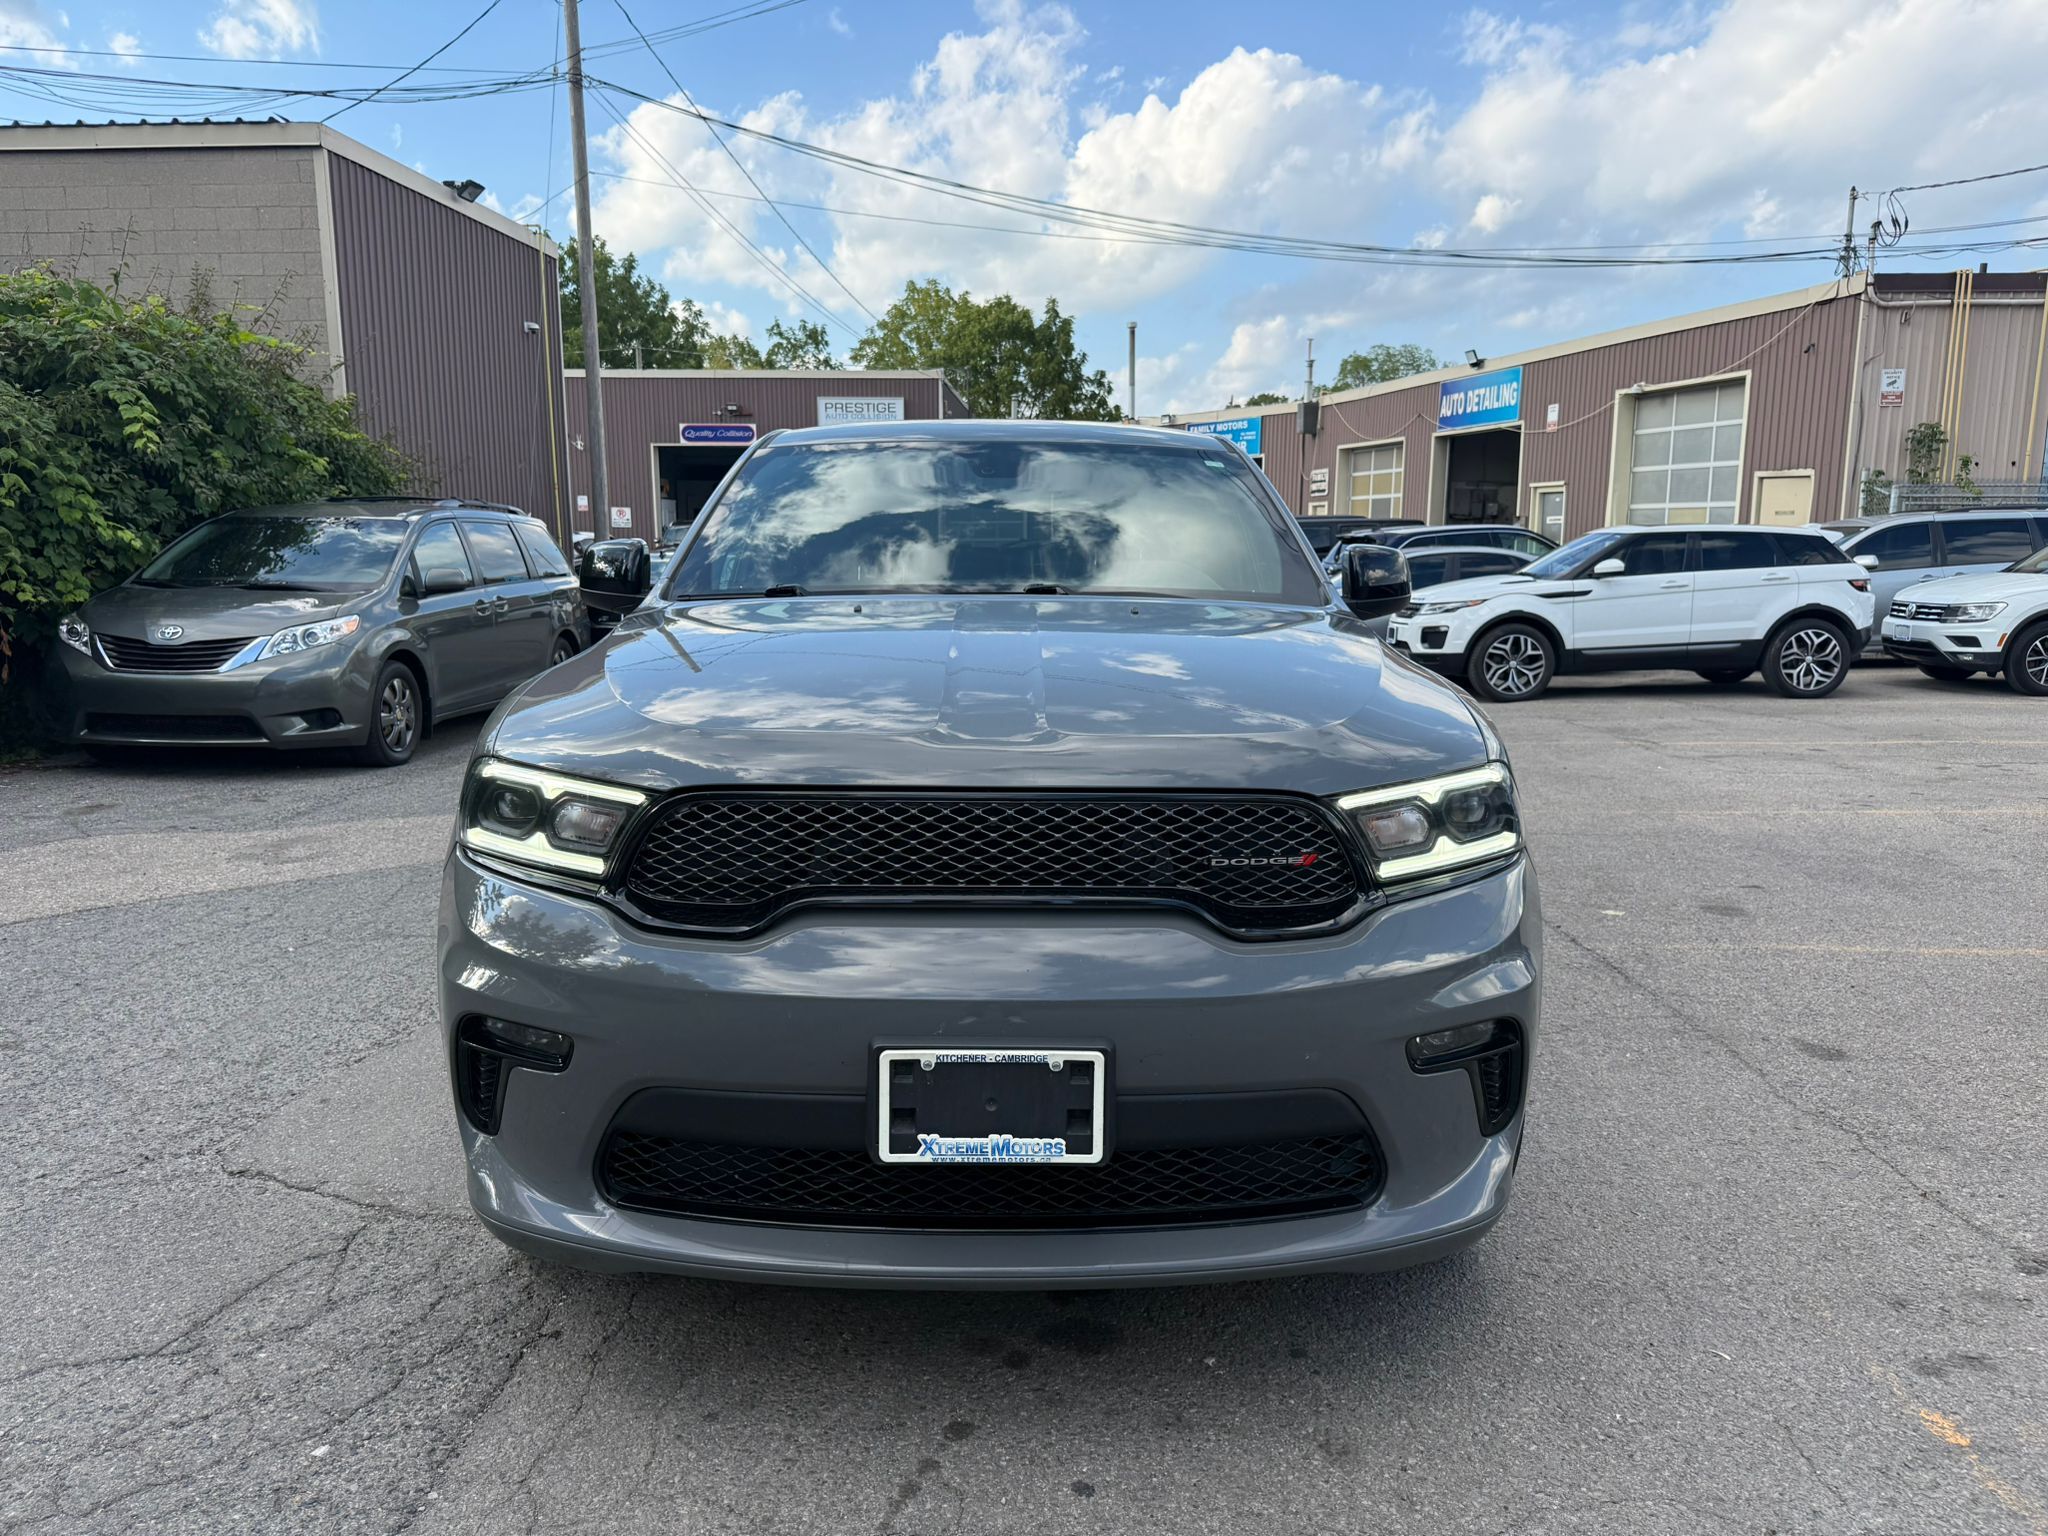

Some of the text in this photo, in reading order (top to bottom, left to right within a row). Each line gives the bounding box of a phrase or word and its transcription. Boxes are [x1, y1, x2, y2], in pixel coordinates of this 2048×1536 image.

[1440, 381, 1518, 417] AUTO DETAILING
[824, 402, 897, 413] PRESTIGE
[1189, 420, 1248, 434] FAMILY MOTORS
[684, 429, 753, 438] Quality Collision
[1211, 857, 1304, 866] DODGE
[935, 1054, 987, 1063] KITCHENER
[994, 1054, 1049, 1063] CAMBRIDGE
